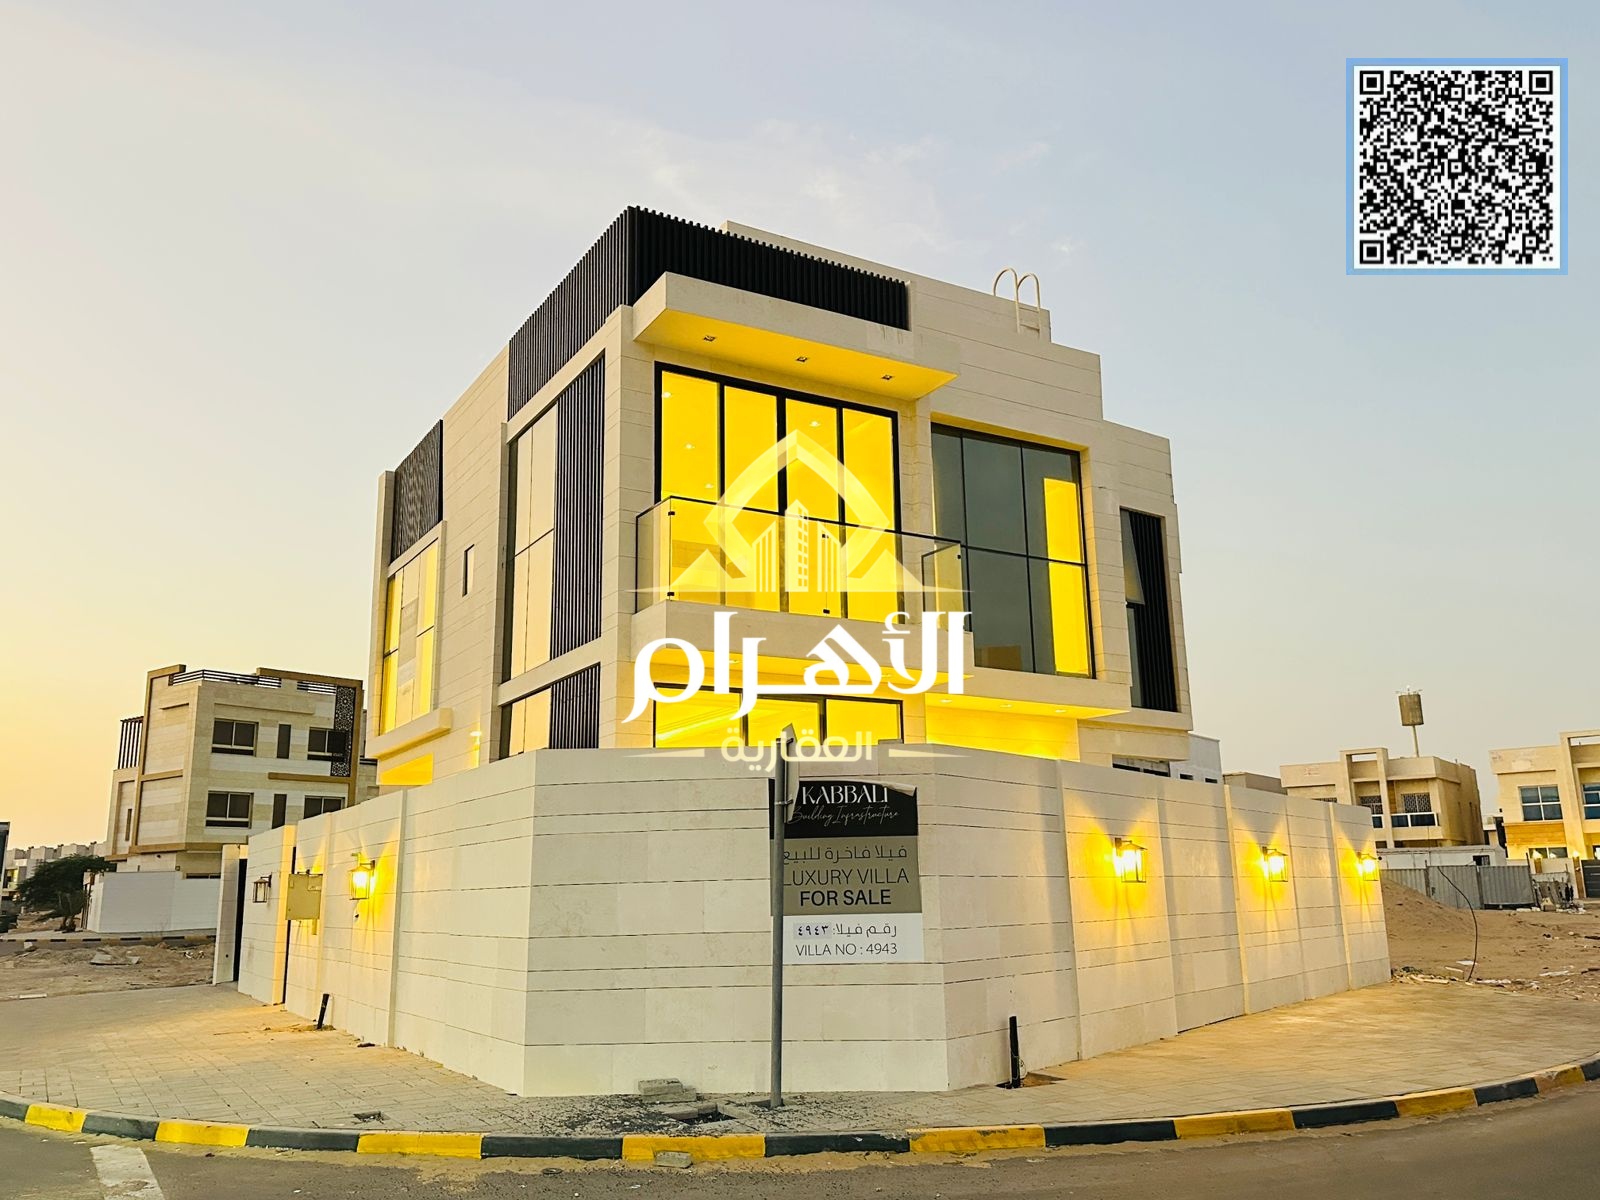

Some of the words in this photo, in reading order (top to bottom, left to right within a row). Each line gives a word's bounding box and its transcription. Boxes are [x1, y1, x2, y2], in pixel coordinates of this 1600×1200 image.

[832, 804, 899, 827] Infrastructure
[824, 845, 871, 864] فاخرة
[875, 845, 908, 862] فيلا
[857, 868, 909, 884] VILLA
[800, 890, 838, 906] FOR
[843, 889, 891, 905] SALE
[798, 925, 829, 936] ٤٩٤٣
[866, 923, 897, 938] رقم
[795, 944, 832, 956] VILLA
[866, 942, 898, 955] 4943
